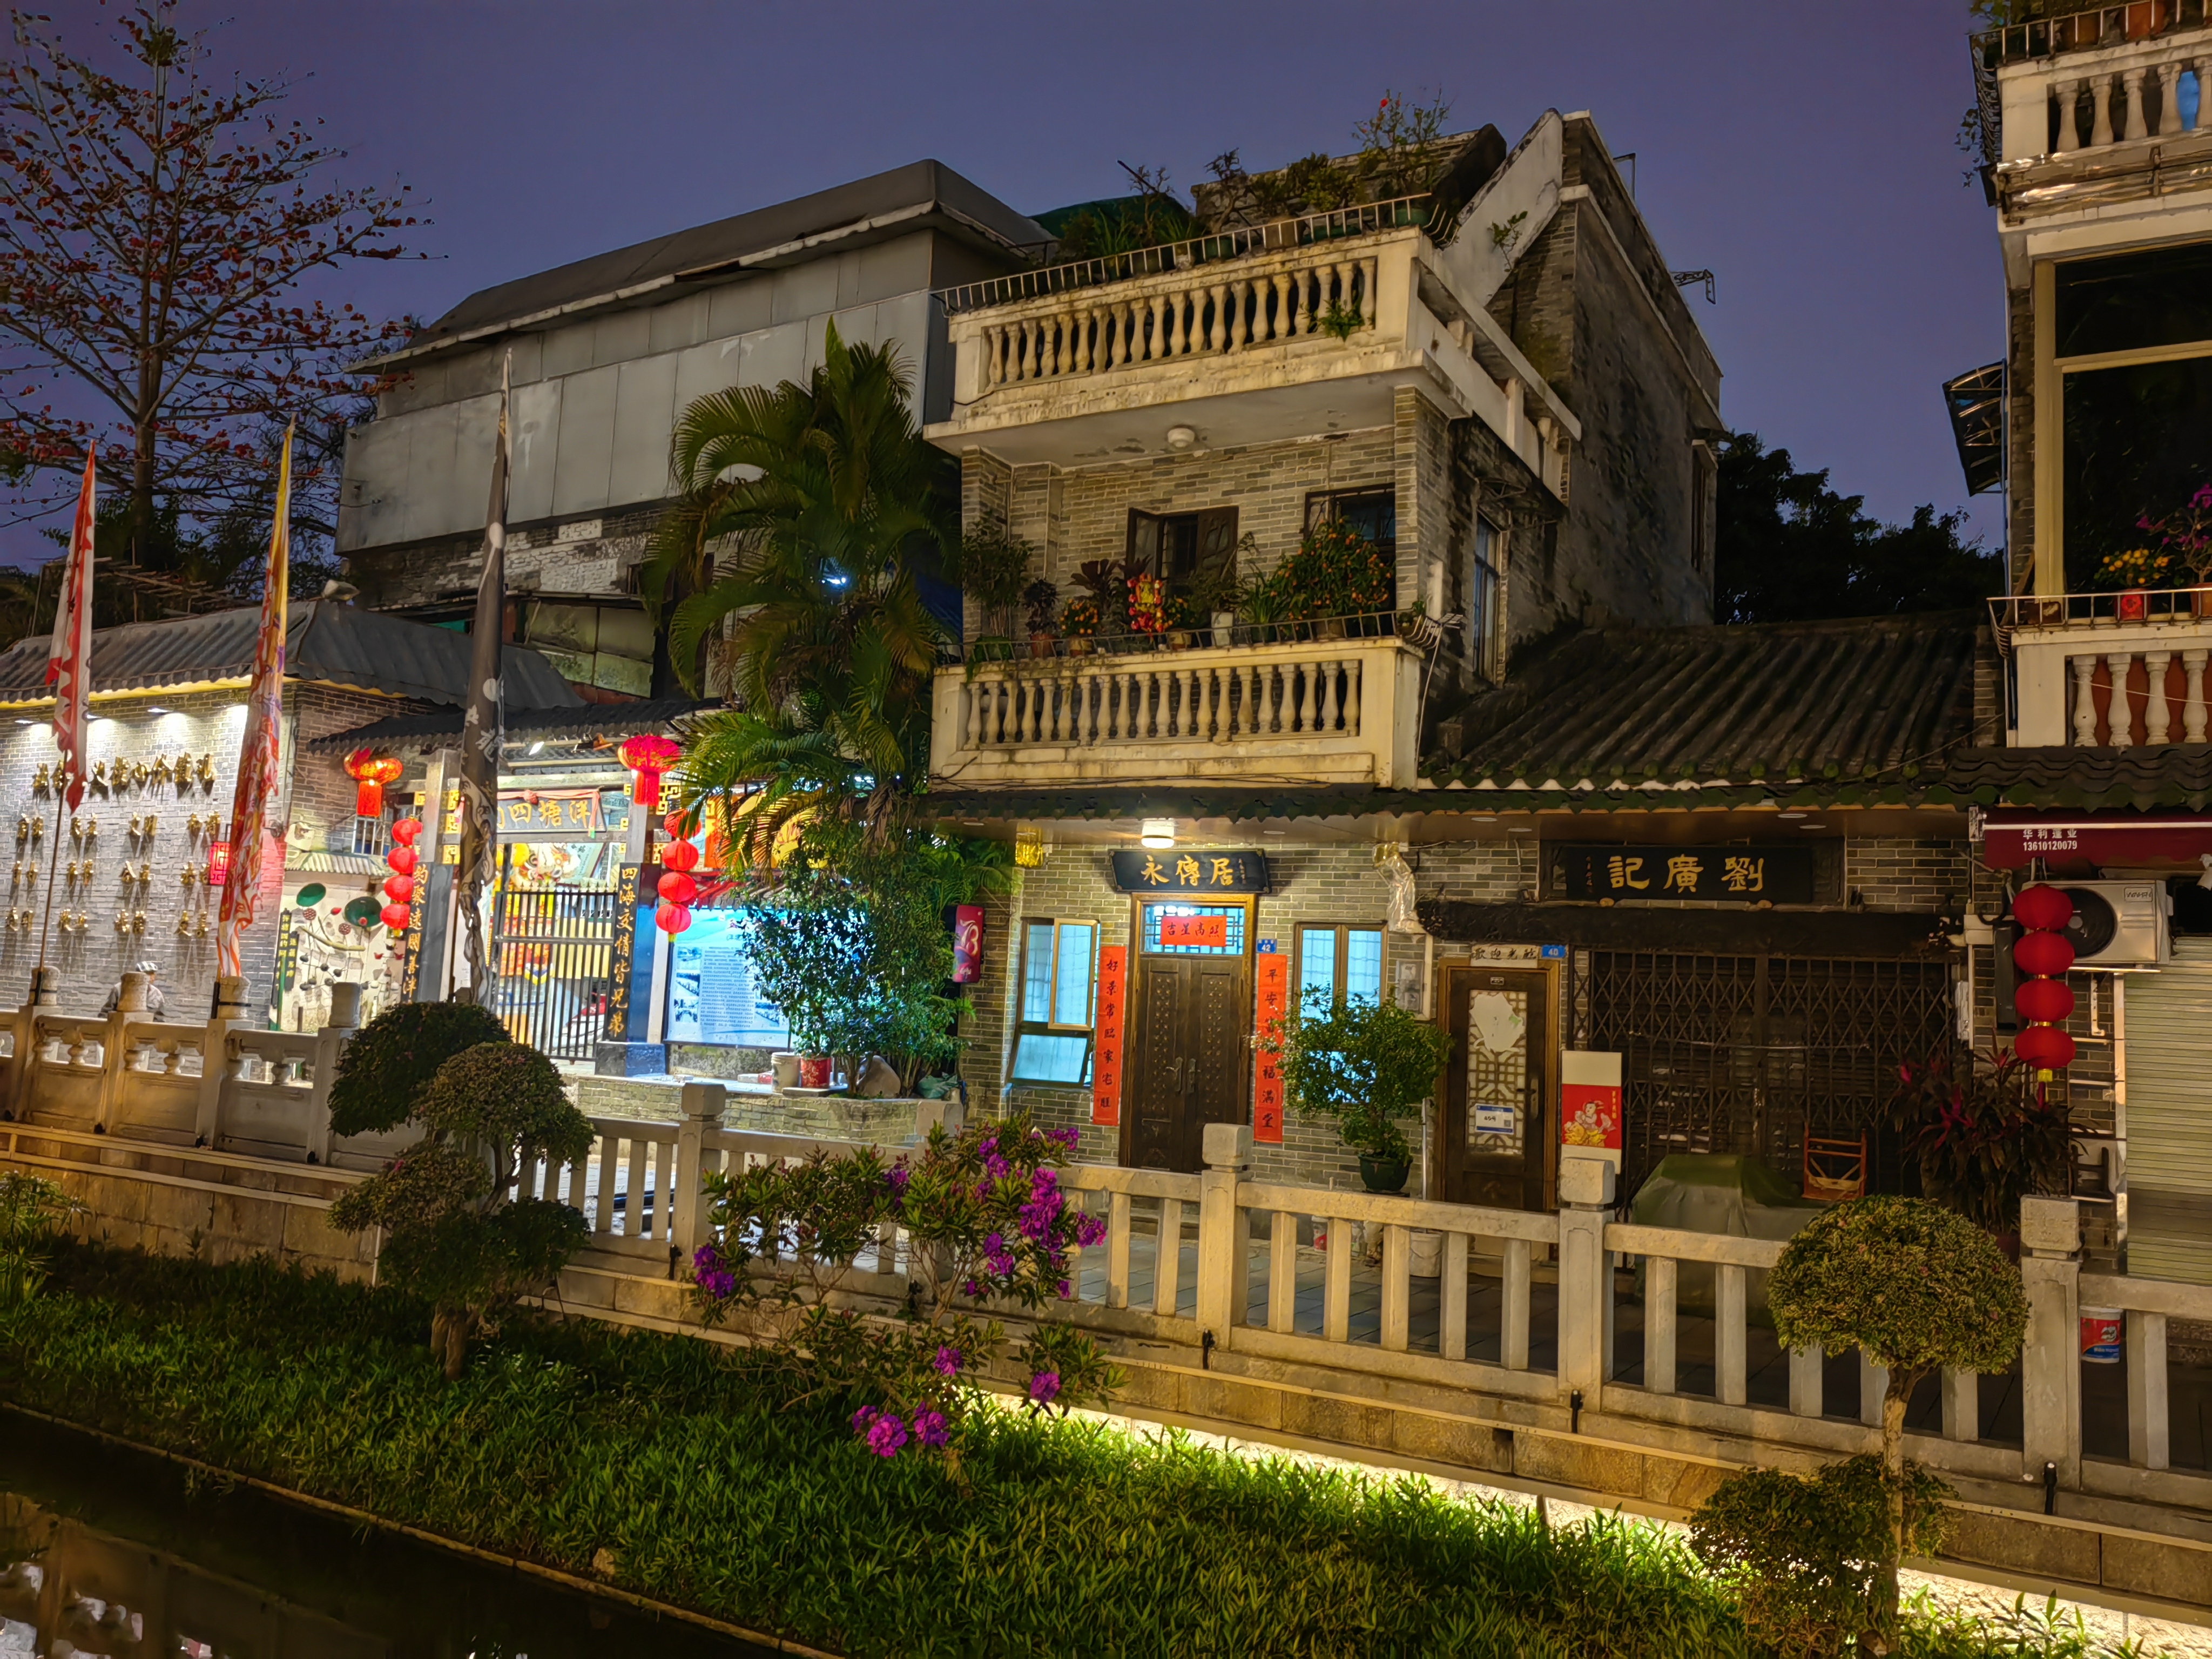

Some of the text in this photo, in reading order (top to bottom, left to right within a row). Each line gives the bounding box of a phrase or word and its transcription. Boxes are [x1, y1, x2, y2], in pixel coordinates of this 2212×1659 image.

[32, 752, 216, 788] 社会义核心价值观
[2023, 840, 2077, 851] 13610120079
[1141, 854, 1233, 886] 永傳居
[1607, 854, 1764, 893] 劉廣記
[1167, 922, 1219, 938] 吉星高照
[608, 867, 638, 1037] 四海交情皆兄弟
[1548, 948, 1559, 956] 40
